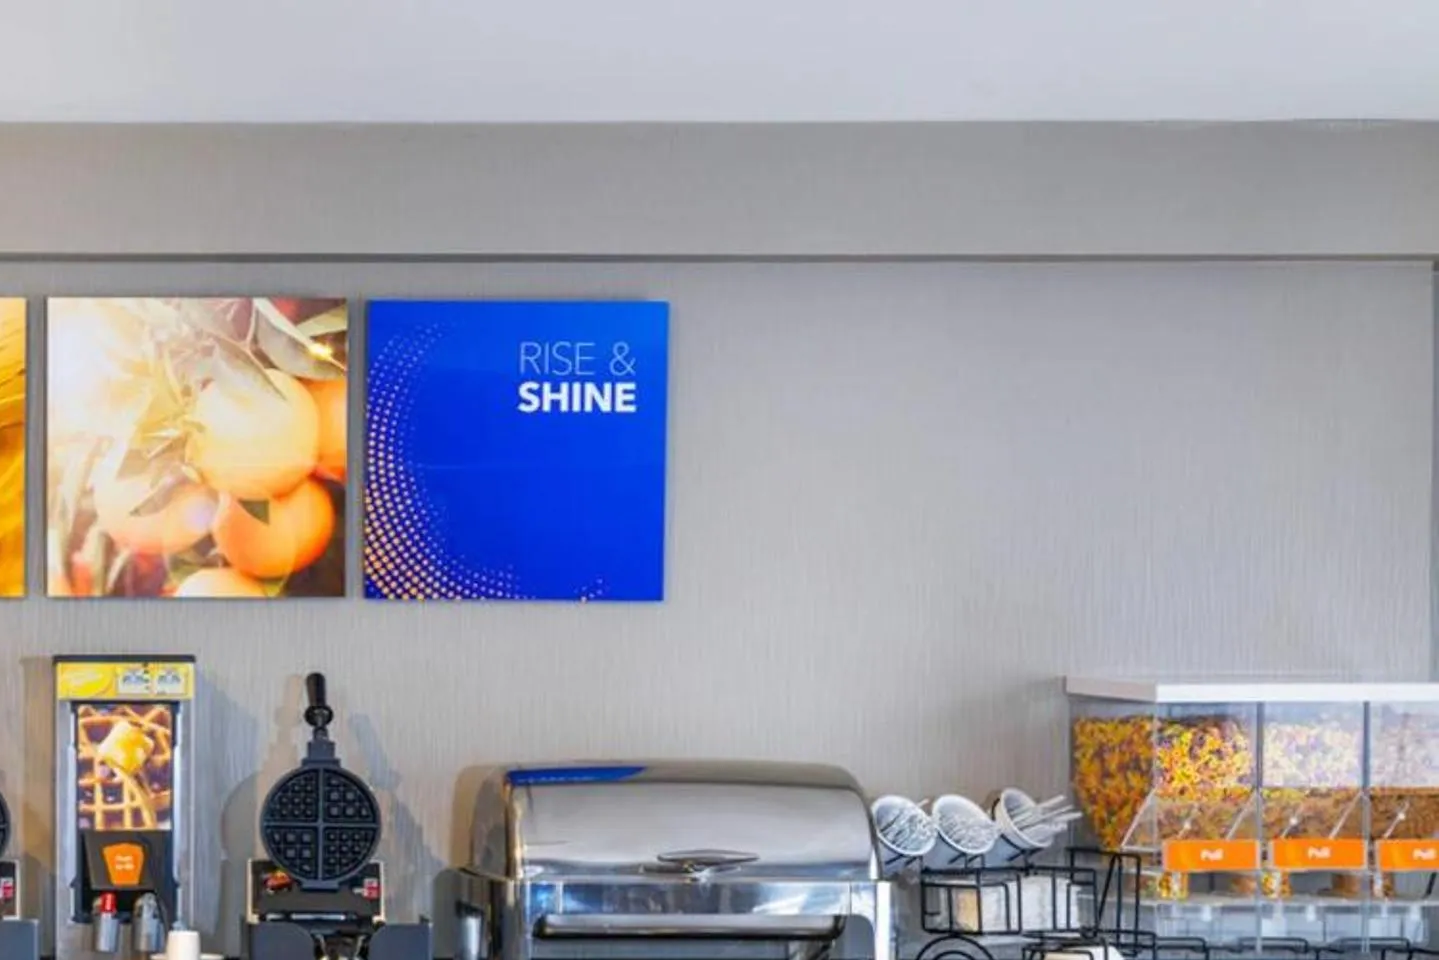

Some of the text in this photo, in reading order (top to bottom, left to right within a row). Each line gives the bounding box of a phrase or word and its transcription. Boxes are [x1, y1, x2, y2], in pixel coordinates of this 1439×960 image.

[520, 341, 636, 375] RISE &
[518, 380, 637, 413] SHINE
